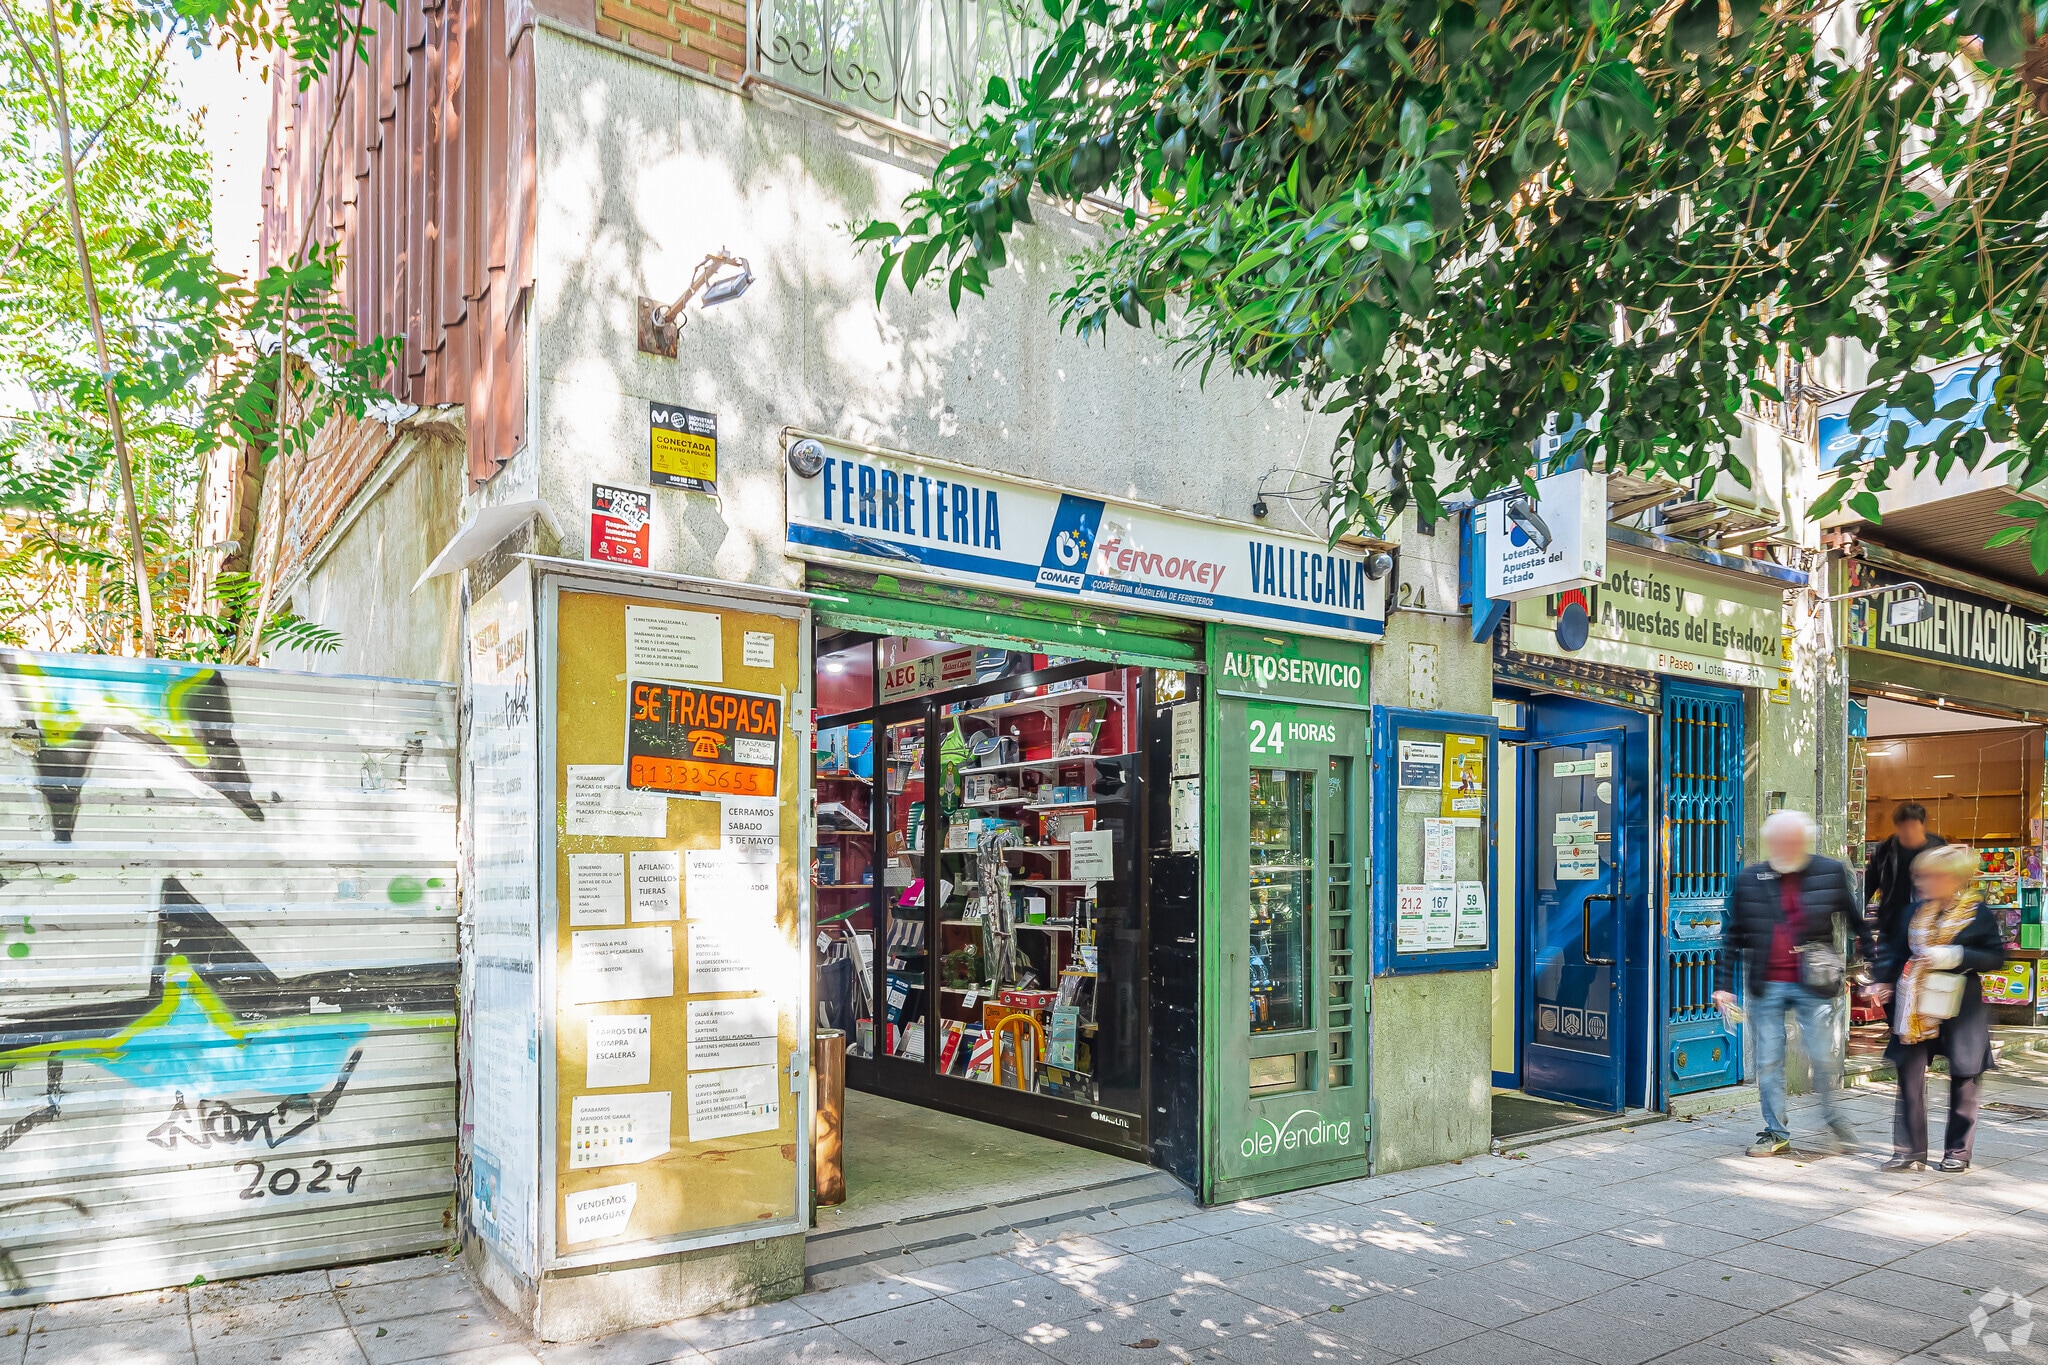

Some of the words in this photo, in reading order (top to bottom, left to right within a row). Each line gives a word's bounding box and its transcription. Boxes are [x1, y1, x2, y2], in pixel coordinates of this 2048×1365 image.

[657, 436, 711, 452] CONECTADA
[596, 487, 647, 506] SECTOR
[823, 457, 1002, 551] FERRETERIA
[1503, 557, 1546, 574] Apuestas
[1548, 552, 1563, 563] del
[1041, 570, 1080, 585] COMAFE
[1249, 541, 1365, 611] VALLECANA
[1503, 572, 1534, 586] Estado
[1092, 580, 1133, 594] COOPERATIVA
[1134, 585, 1168, 600] MADRILEÑA
[1168, 592, 1177, 600] DE
[1177, 593, 1214, 606] FERRETEROS
[1400, 582, 1427, 608] 24
[1676, 586, 1685, 612] y
[1602, 601, 1680, 639] Apuestas
[1685, 616, 1708, 644] del
[1713, 622, 1762, 653] Estado
[2027, 630, 2039, 665] &
[1223, 652, 1361, 689] AUTOSERVICIO
[1658, 653, 1666, 667] El
[1670, 655, 1694, 671] Paseo
[884, 666, 916, 690] AEG
[634, 685, 662, 722] SE
[668, 689, 777, 736] TRASPASA
[737, 740, 770, 749] TRASPASO
[1250, 720, 1284, 754] 24
[1289, 722, 1336, 742] HORAS
[729, 808, 774, 816] CERRAMOS
[729, 822, 762, 830] SABADO
[638, 863, 674, 871] AFILAMOS
[1401, 897, 1422, 911] 21,2
[1432, 896, 1448, 908] 167
[1467, 894, 1477, 905] 59
[596, 1051, 636, 1059] ESCALERAS
[714, 1103, 743, 1112] MAGNETICAS
[721, 1110, 749, 1118] PROXIMIDAD
[234, 1159, 362, 1199] 2021
[577, 1195, 626, 1211] VENDEMOS
[579, 1209, 626, 1224] PARAGUAS
